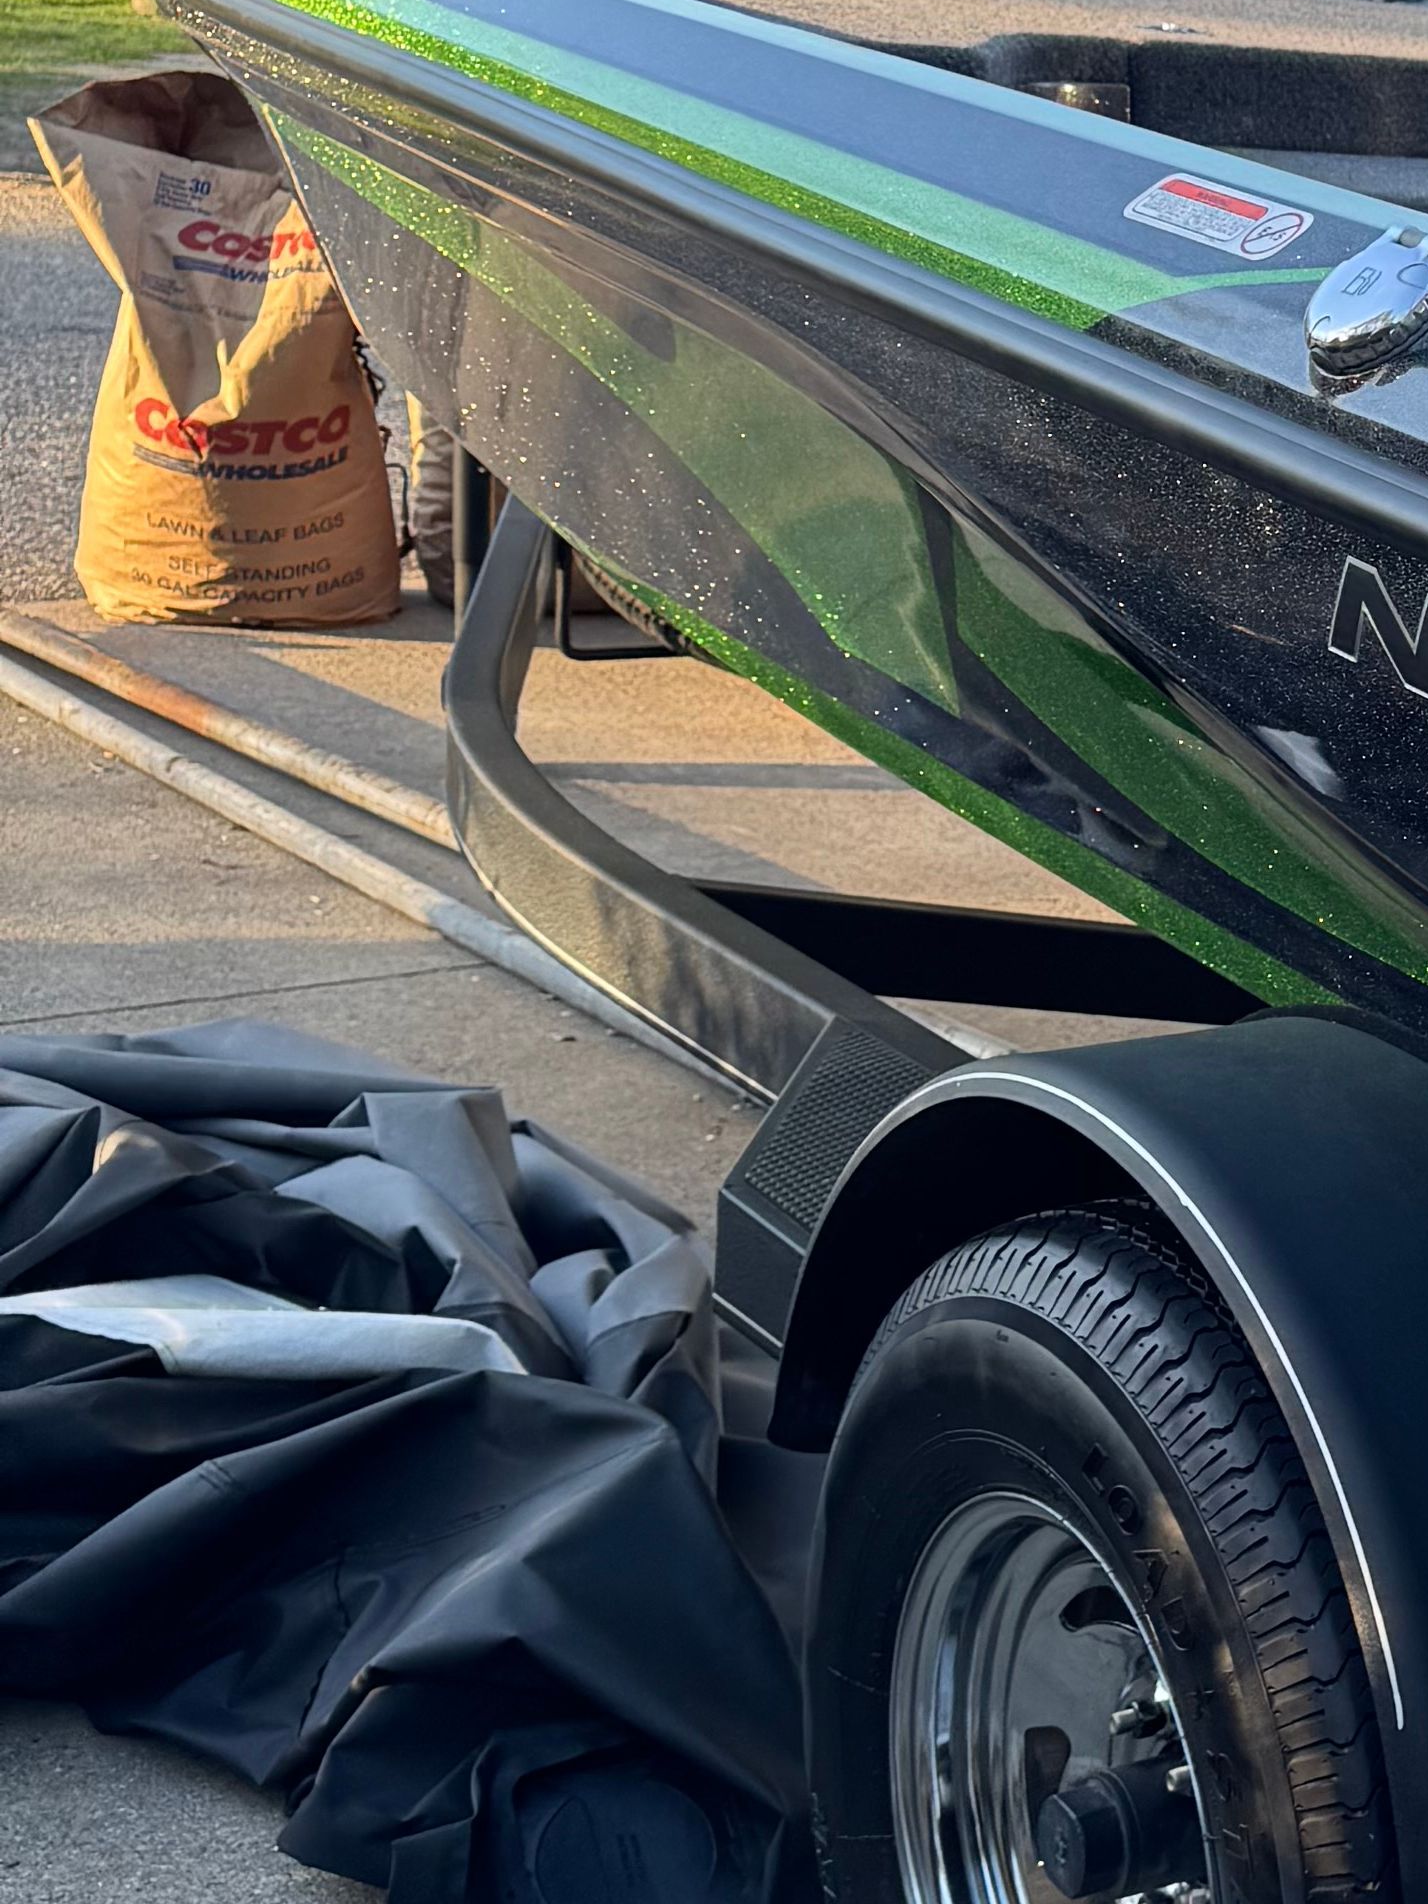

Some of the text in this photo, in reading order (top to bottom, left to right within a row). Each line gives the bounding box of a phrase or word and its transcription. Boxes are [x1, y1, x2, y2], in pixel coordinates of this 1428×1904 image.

[134, 397, 350, 456] COSTCO
[198, 445, 349, 481] WHOLESALE
[146, 511, 204, 542] LAWN
[231, 526, 287, 544] LEAF
[293, 511, 345, 541] BAGS
[167, 555, 332, 584] SELF STANDING
[202, 583, 310, 604] CAPACITY
[315, 566, 365, 597] BAGS
